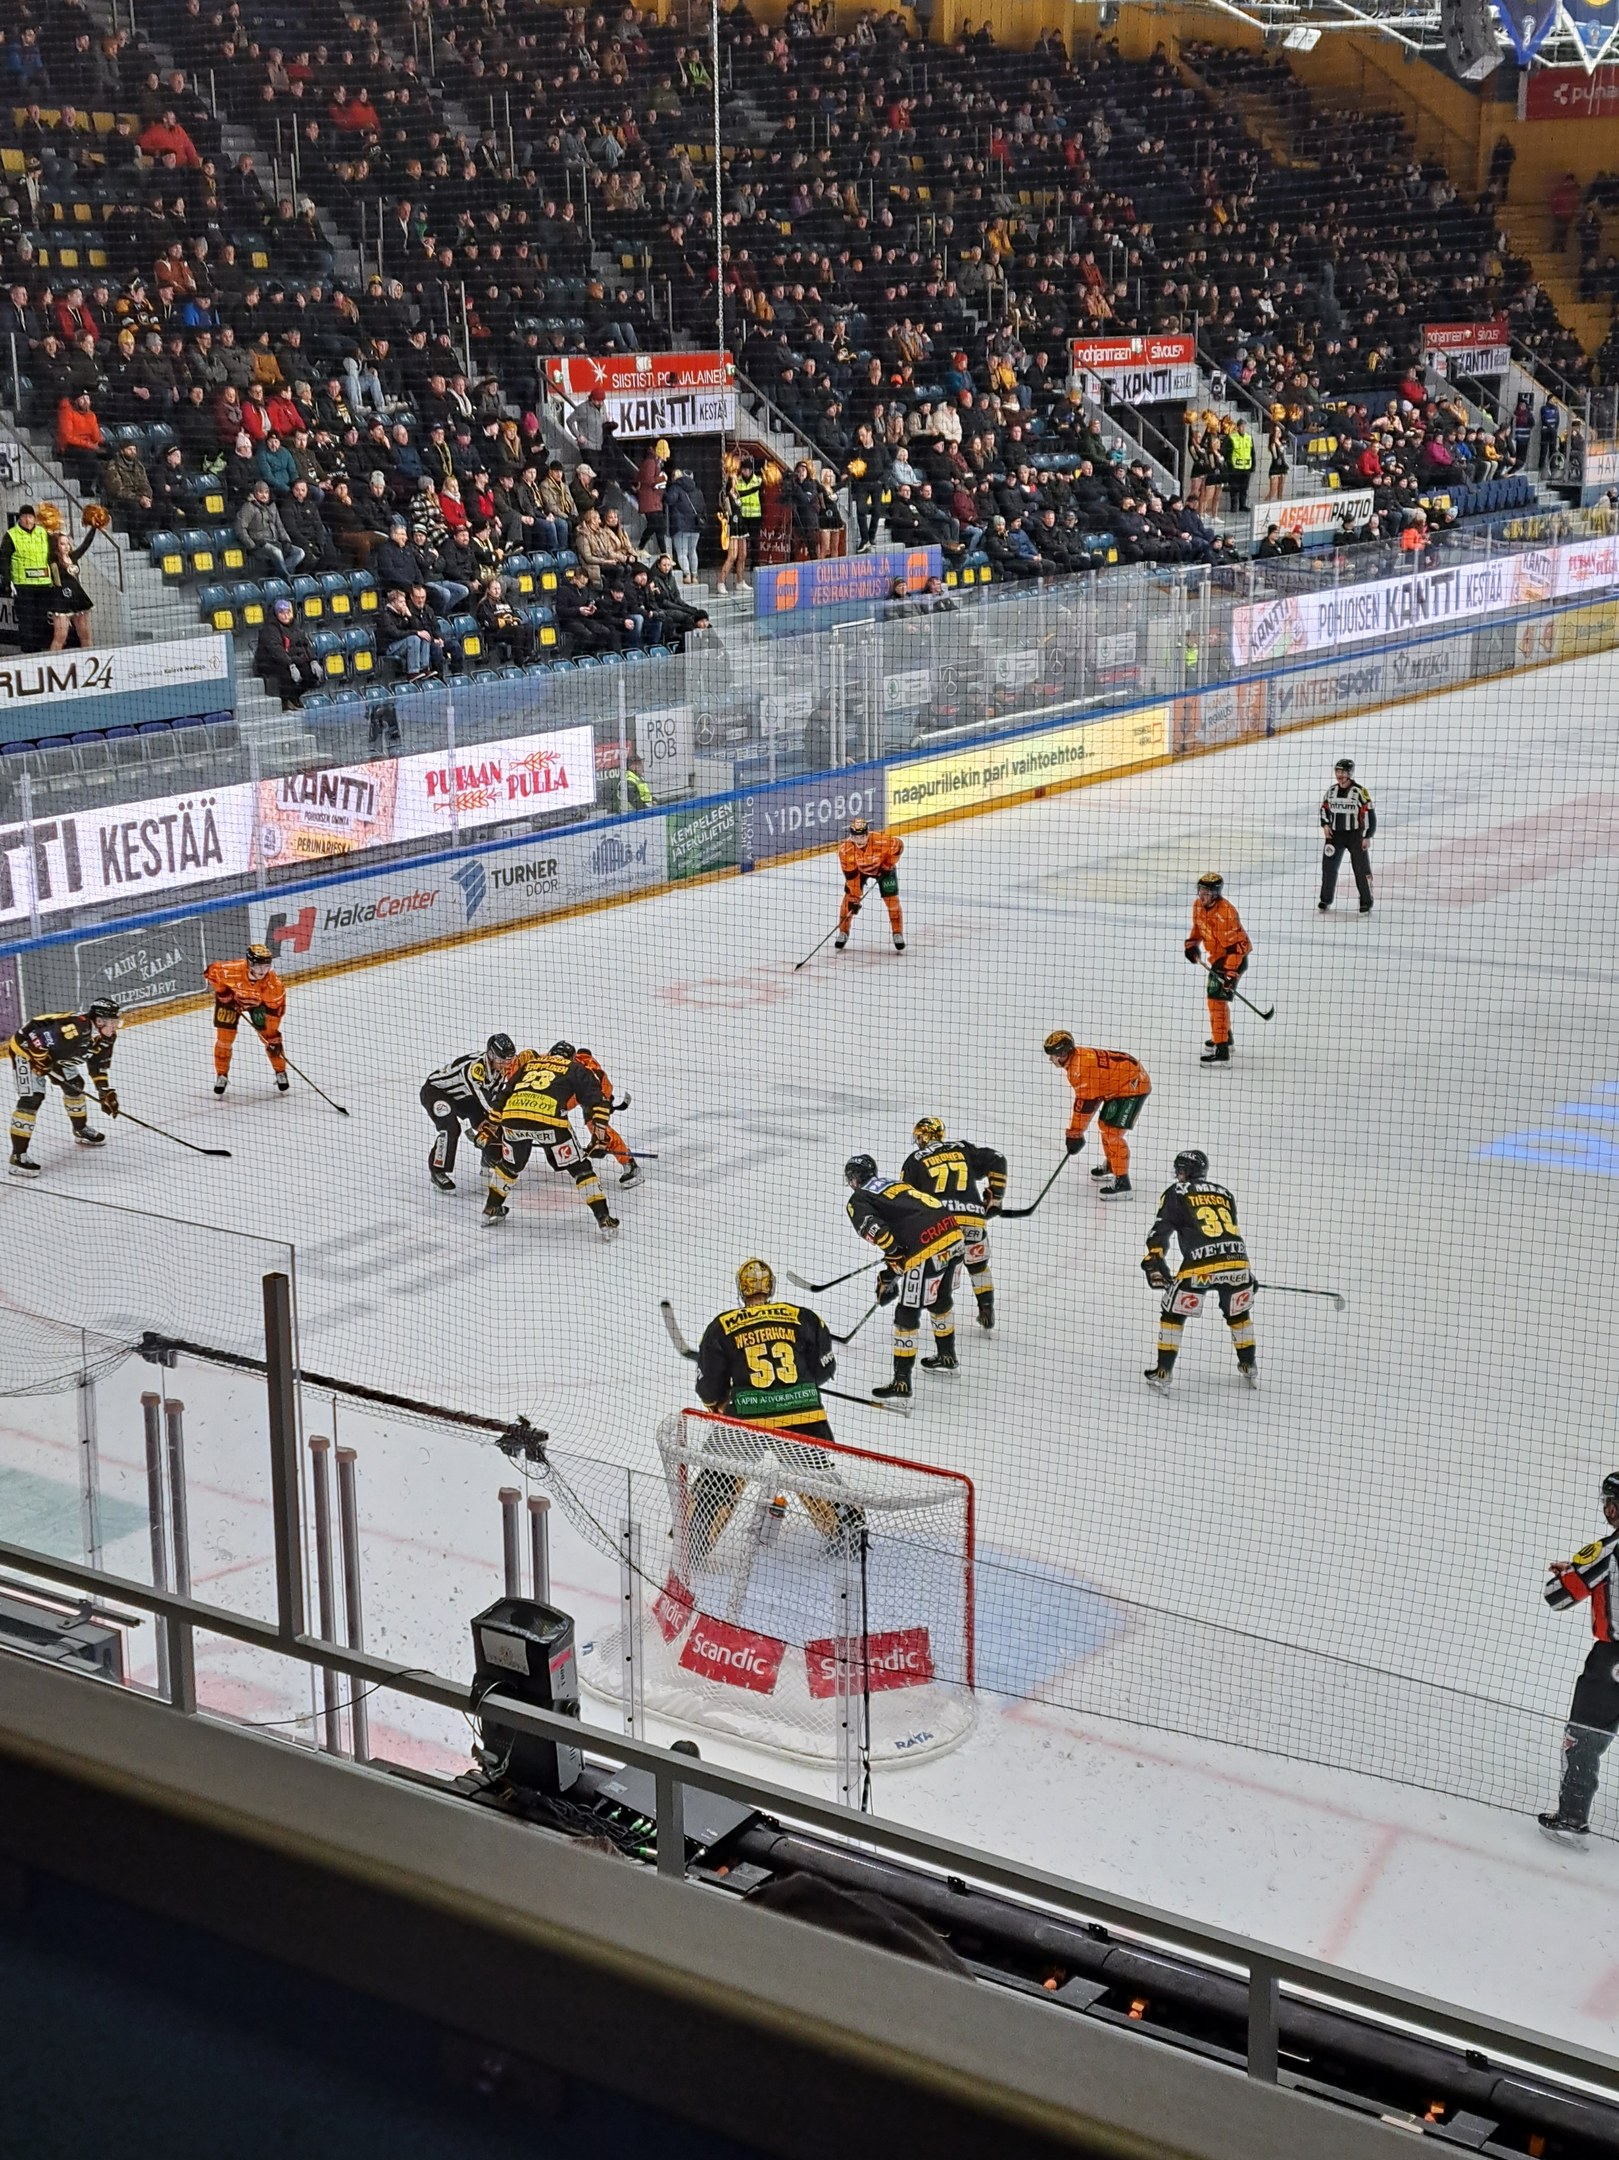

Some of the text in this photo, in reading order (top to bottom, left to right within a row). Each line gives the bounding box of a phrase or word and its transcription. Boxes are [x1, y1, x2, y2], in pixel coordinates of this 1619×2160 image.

[657, 368, 727, 387] POJALAINEN
[1122, 368, 1172, 400] KANTTI
[619, 394, 696, 434] KANTTI
[816, 562, 848, 585] OULUN
[1318, 562, 1503, 641] POHJOISEN KANTTI KESTÄÄ
[81, 654, 115, 690] 24
[1295, 665, 1382, 710] INTERSPORT
[647, 717, 676, 740] PRO
[648, 737, 677, 768] JOB
[282, 773, 375, 817] KANTTI
[505, 766, 569, 800] PULLA
[892, 769, 981, 805] naapurillekin
[983, 764, 1009, 791] pari
[670, 801, 733, 847] KEMPELEEN
[764, 787, 877, 837] VIDEOBOT
[100, 796, 223, 886] KESTÄÄ
[672, 815, 735, 862] JÄTEKULJETUS
[491, 858, 558, 889] TURNER
[526, 878, 559, 898] DOOR
[322, 888, 441, 932] HakaCenter
[104, 954, 137, 981] VAIN
[140, 947, 183, 981] KALAA
[513, 1069, 556, 1091] 23
[928, 1160, 969, 1194] 77
[734, 1326, 797, 1350] WESTERHOLM
[745, 1341, 799, 1389] 53
[691, 1631, 768, 1676] Scandic
[820, 1647, 919, 1681] Scandic
